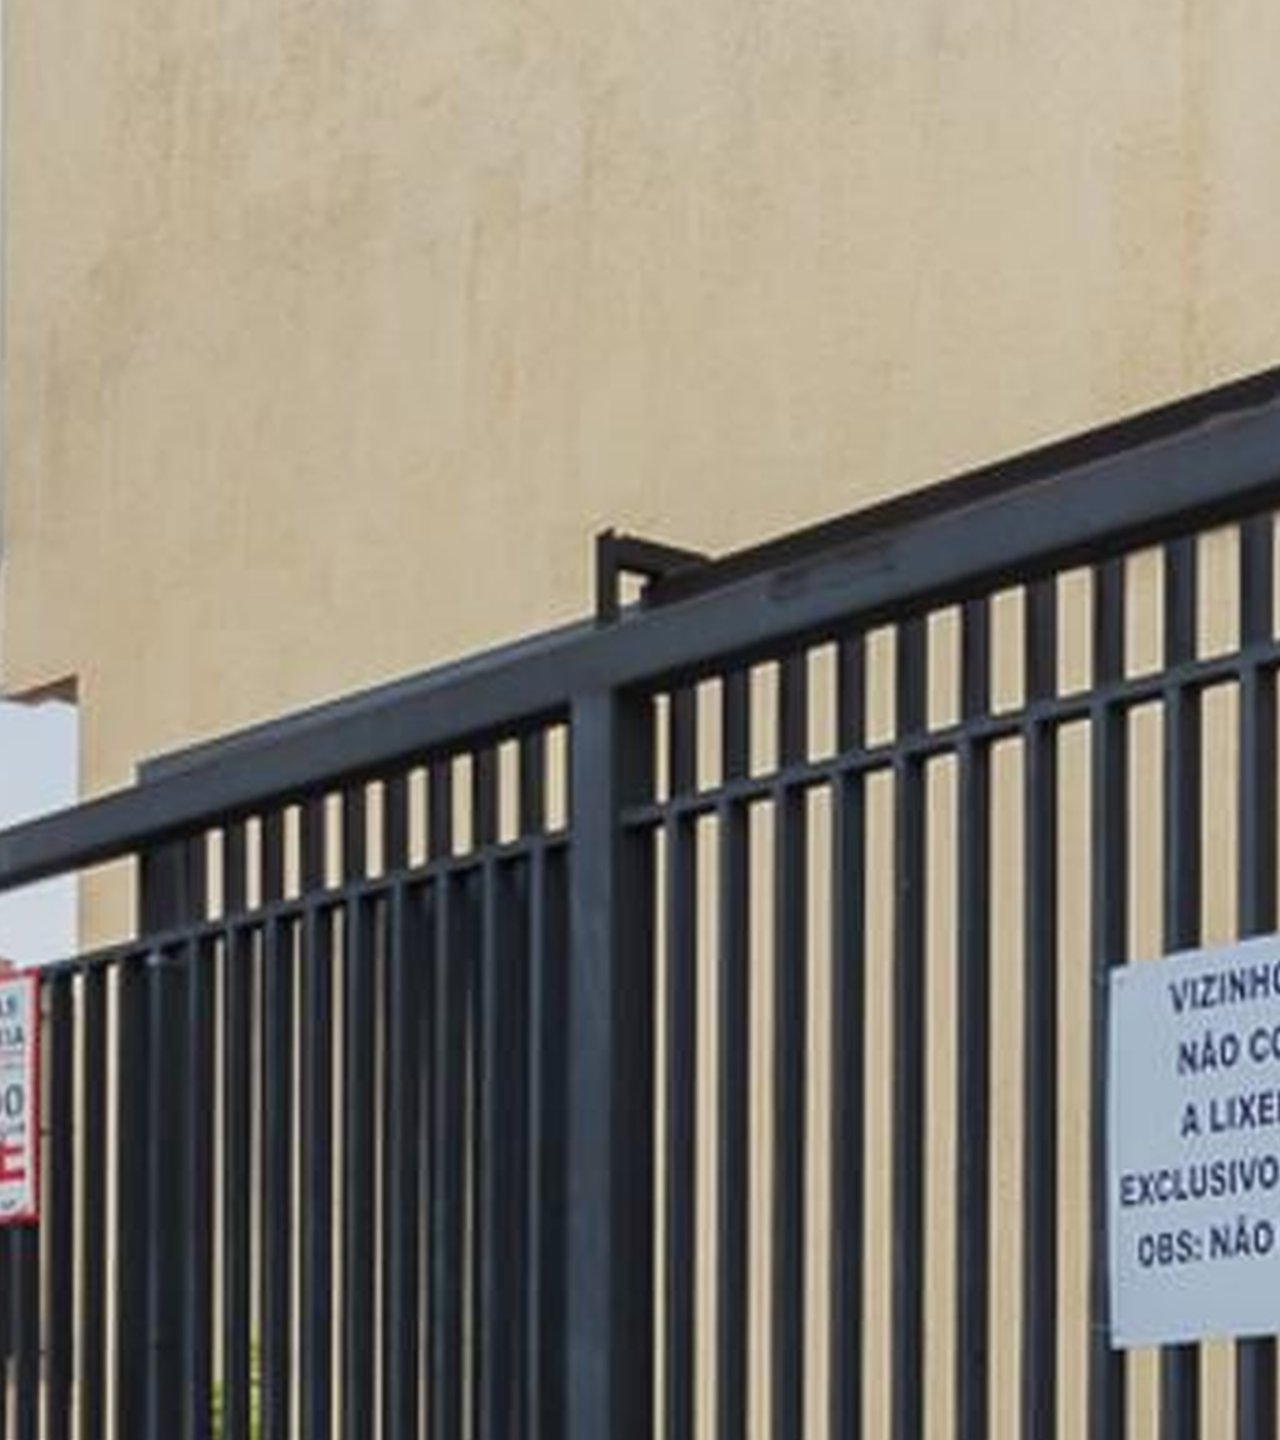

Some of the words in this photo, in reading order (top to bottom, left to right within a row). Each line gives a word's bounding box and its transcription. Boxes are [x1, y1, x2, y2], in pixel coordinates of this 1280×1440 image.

[1181, 1103, 1201, 1137] A
[1120, 1156, 1280, 1208] EXCLUSIVO
[1138, 1233, 1203, 1268] OBS:
